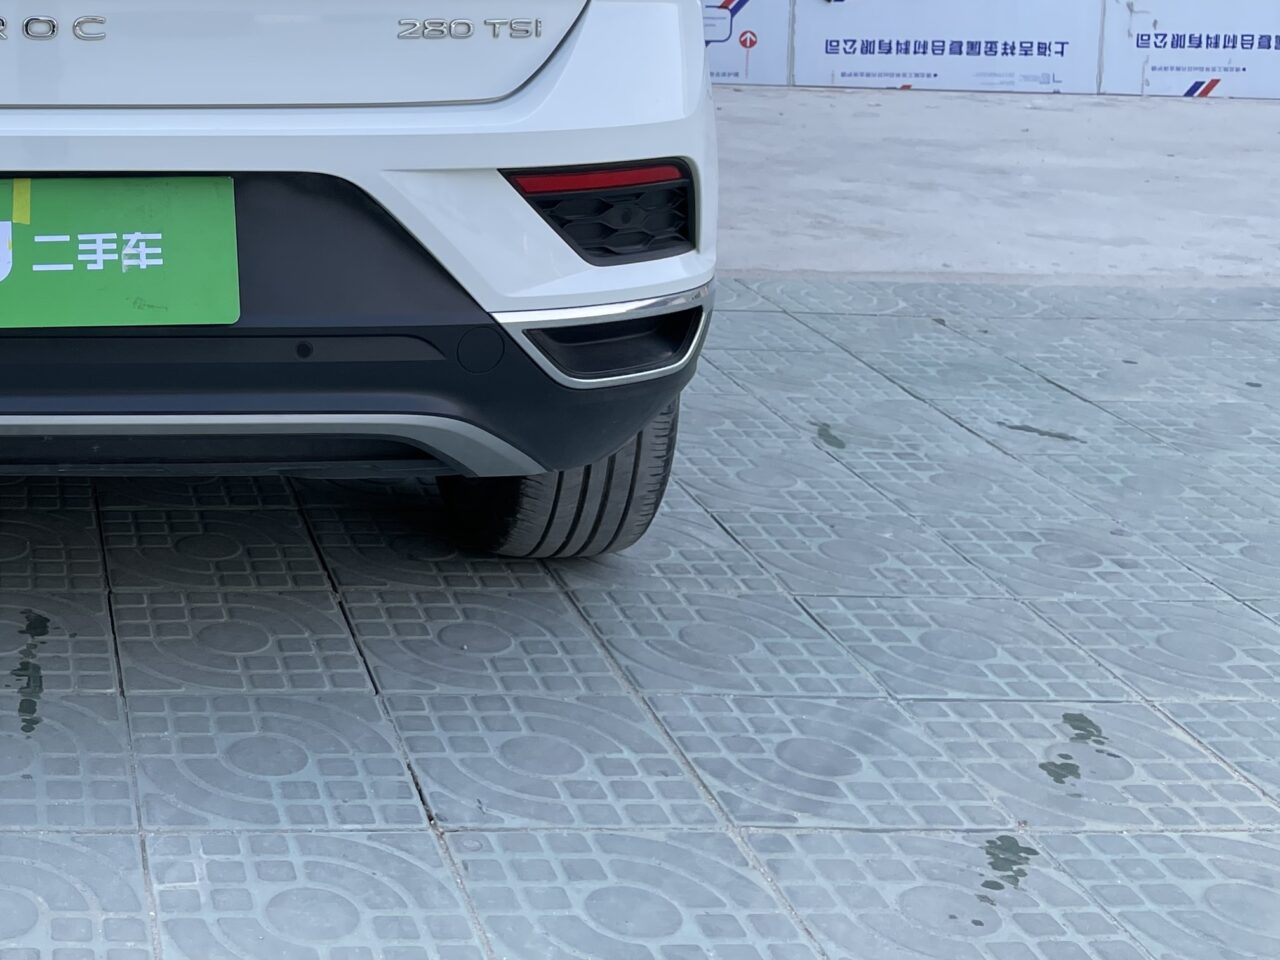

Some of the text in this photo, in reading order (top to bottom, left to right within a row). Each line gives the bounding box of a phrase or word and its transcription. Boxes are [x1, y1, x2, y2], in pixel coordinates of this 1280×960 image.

[397, 18, 542, 39] 280 TSI
[824, 38, 1070, 58] 上海吉祥金属复合材料有限公司
[32, 231, 164, 274] 二手车
